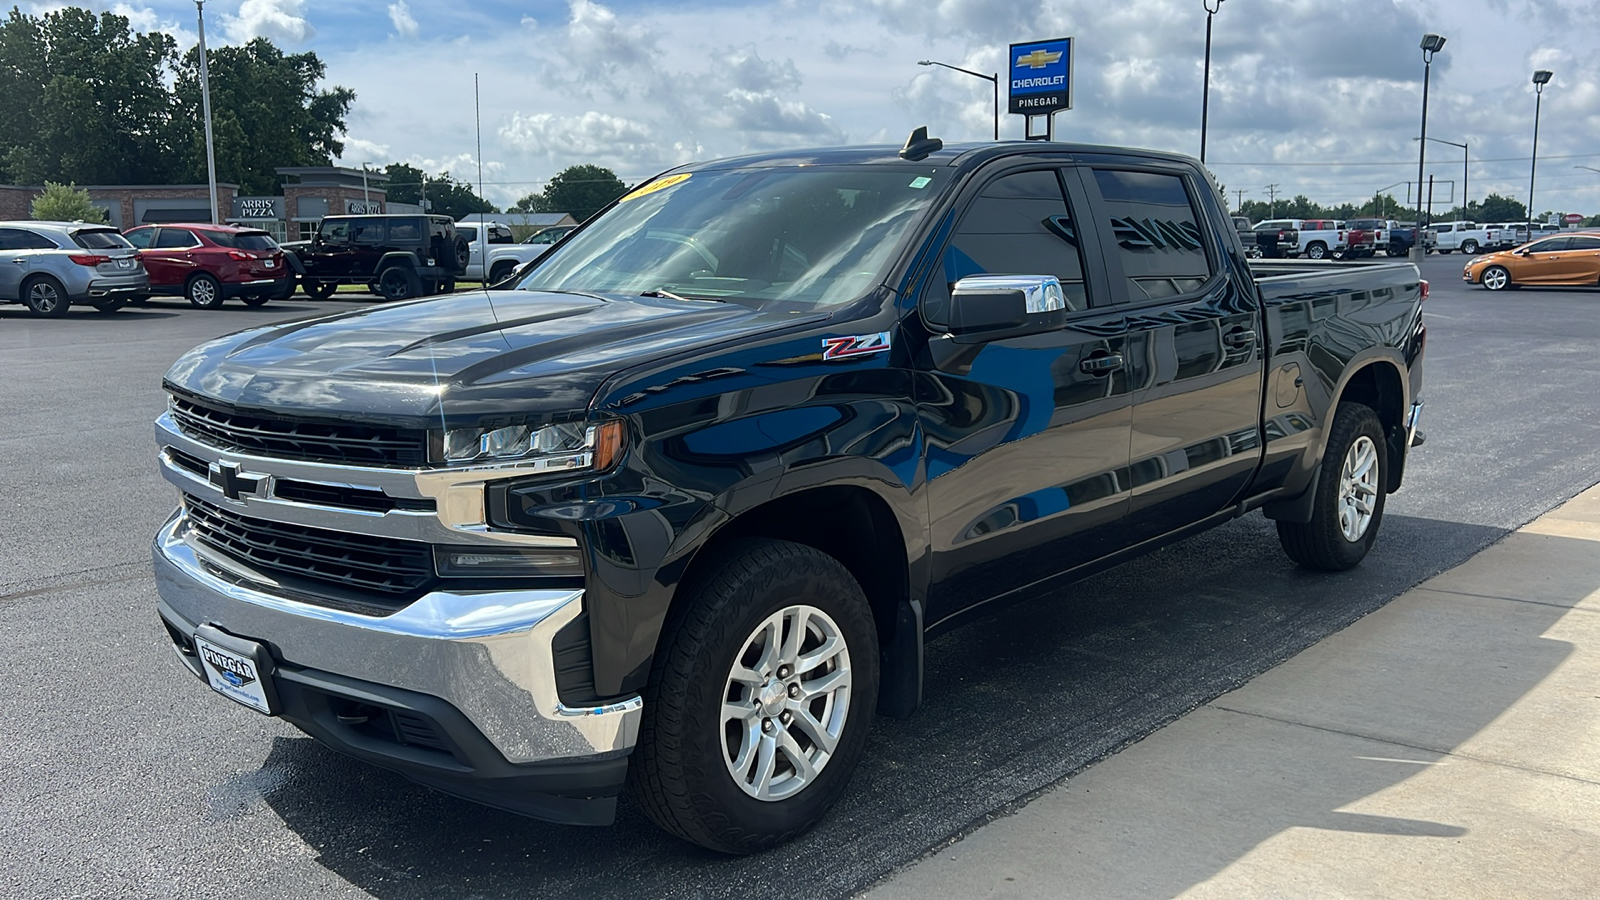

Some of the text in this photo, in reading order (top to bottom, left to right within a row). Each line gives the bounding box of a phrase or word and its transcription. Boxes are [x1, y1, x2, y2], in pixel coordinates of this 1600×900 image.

[1012, 75, 1065, 89] CHEVROLET
[1018, 97, 1058, 107] PINEGAR
[241, 200, 274, 208] ARRIS'
[242, 208, 275, 217] PIZZA
[822, 331, 891, 360] Z71
[203, 648, 254, 679] PINEGAR
